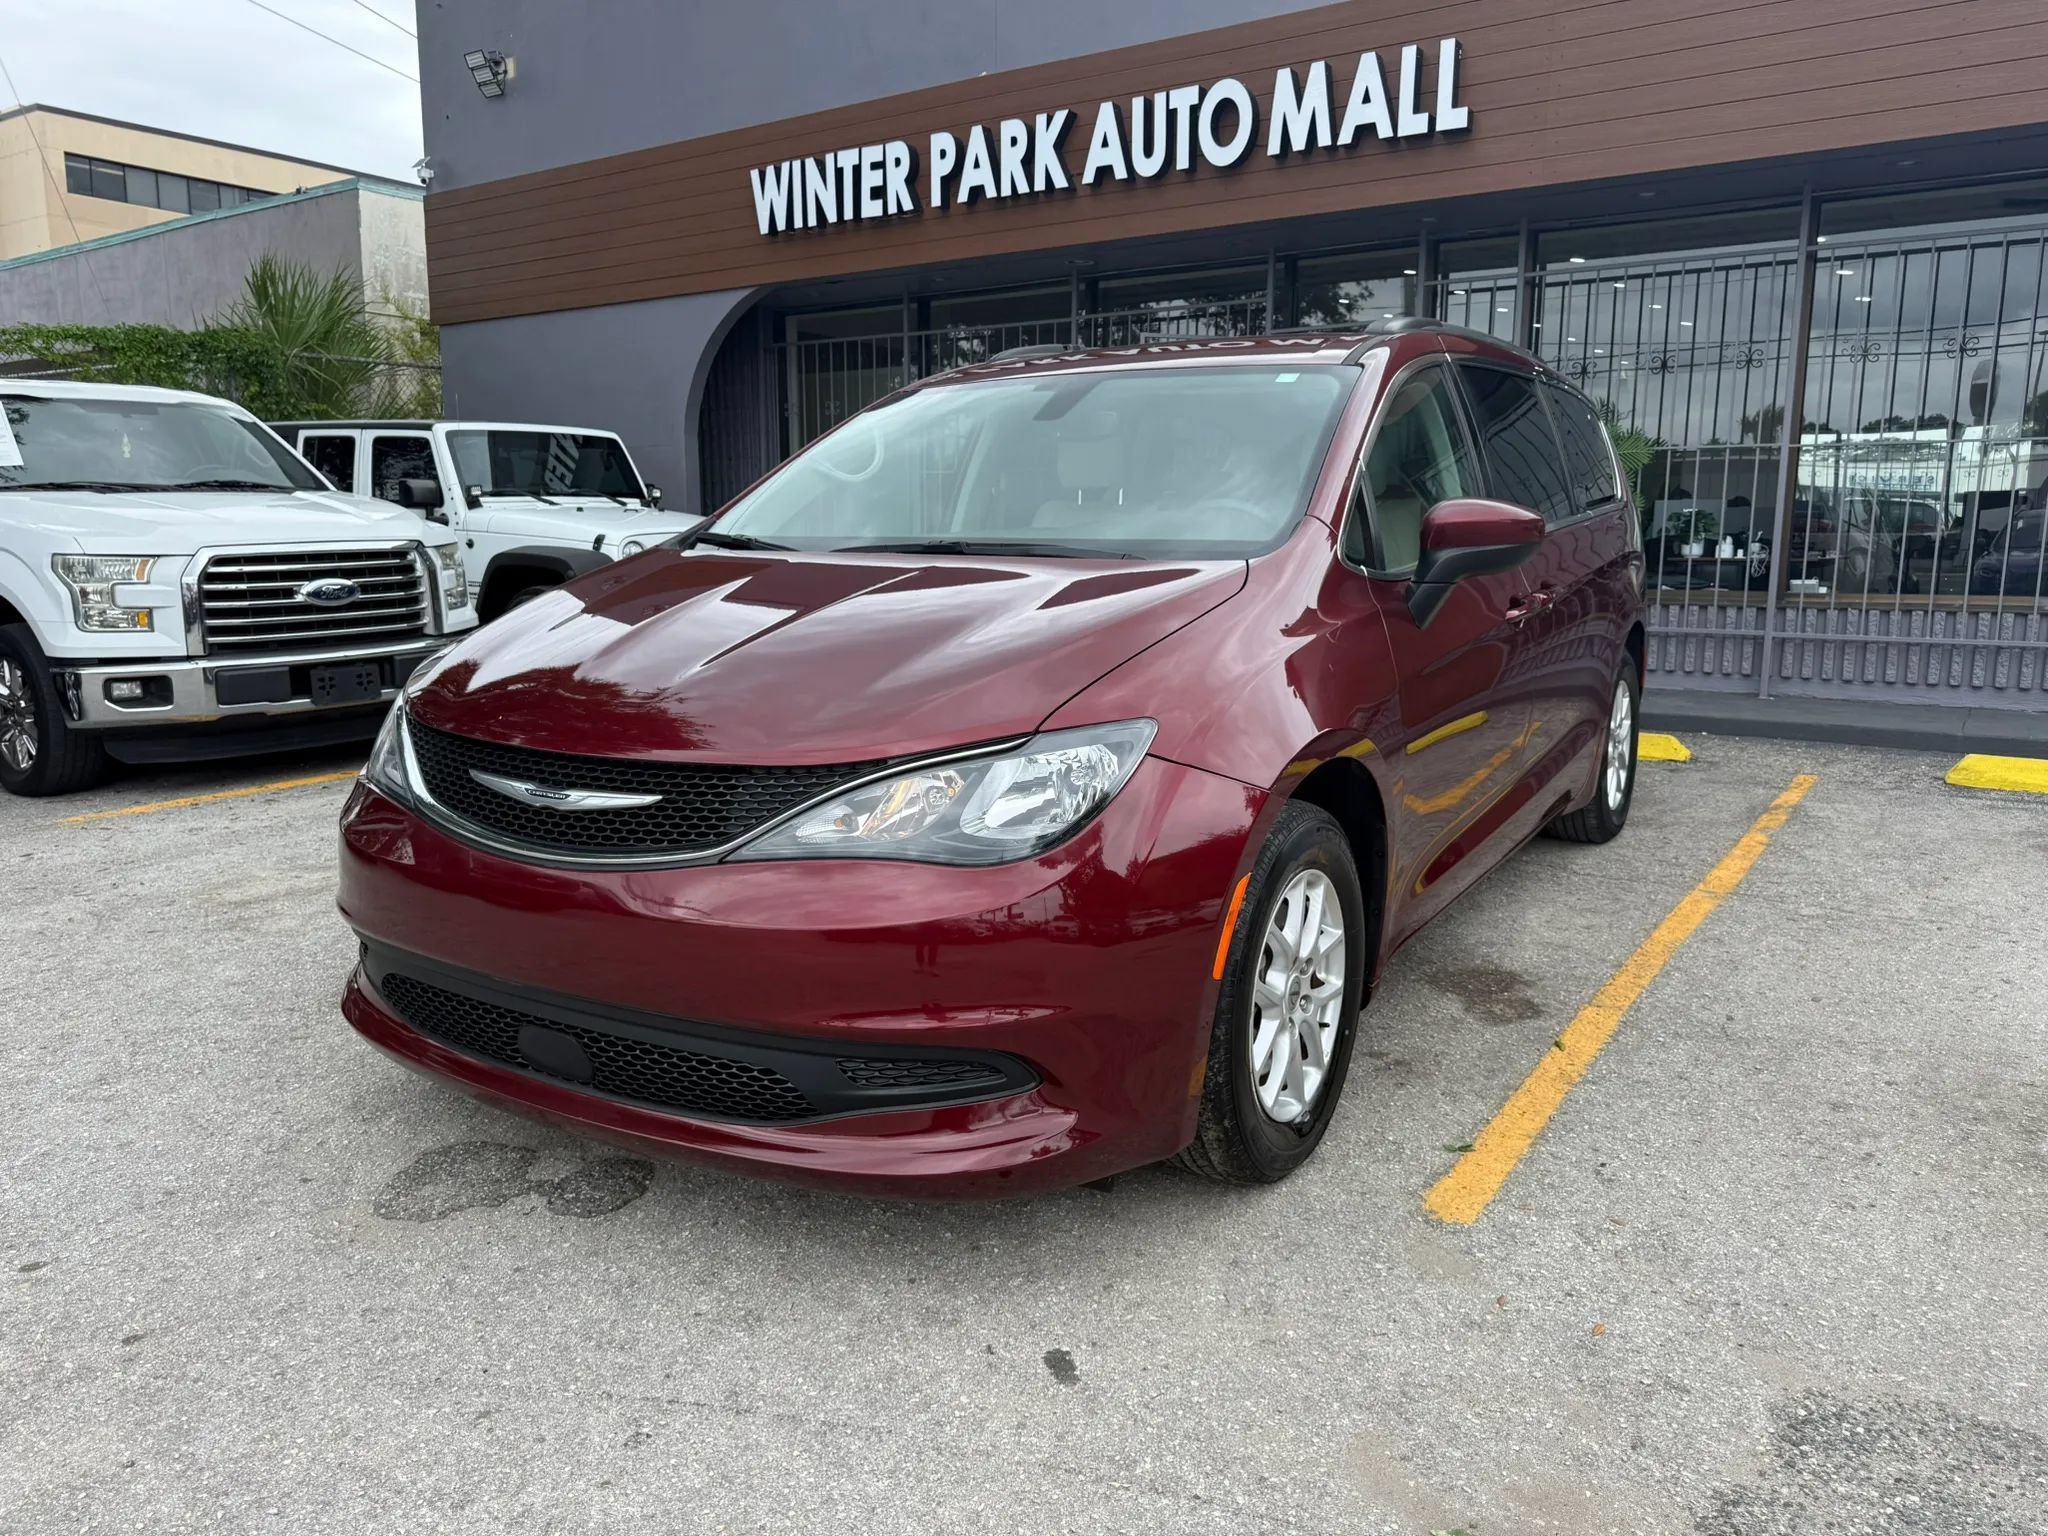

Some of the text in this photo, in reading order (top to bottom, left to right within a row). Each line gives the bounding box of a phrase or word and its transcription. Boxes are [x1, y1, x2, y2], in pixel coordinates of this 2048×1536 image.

[750, 37, 1470, 235] WINTER PARK AUTO MALL
[319, 585, 349, 599] Ford
